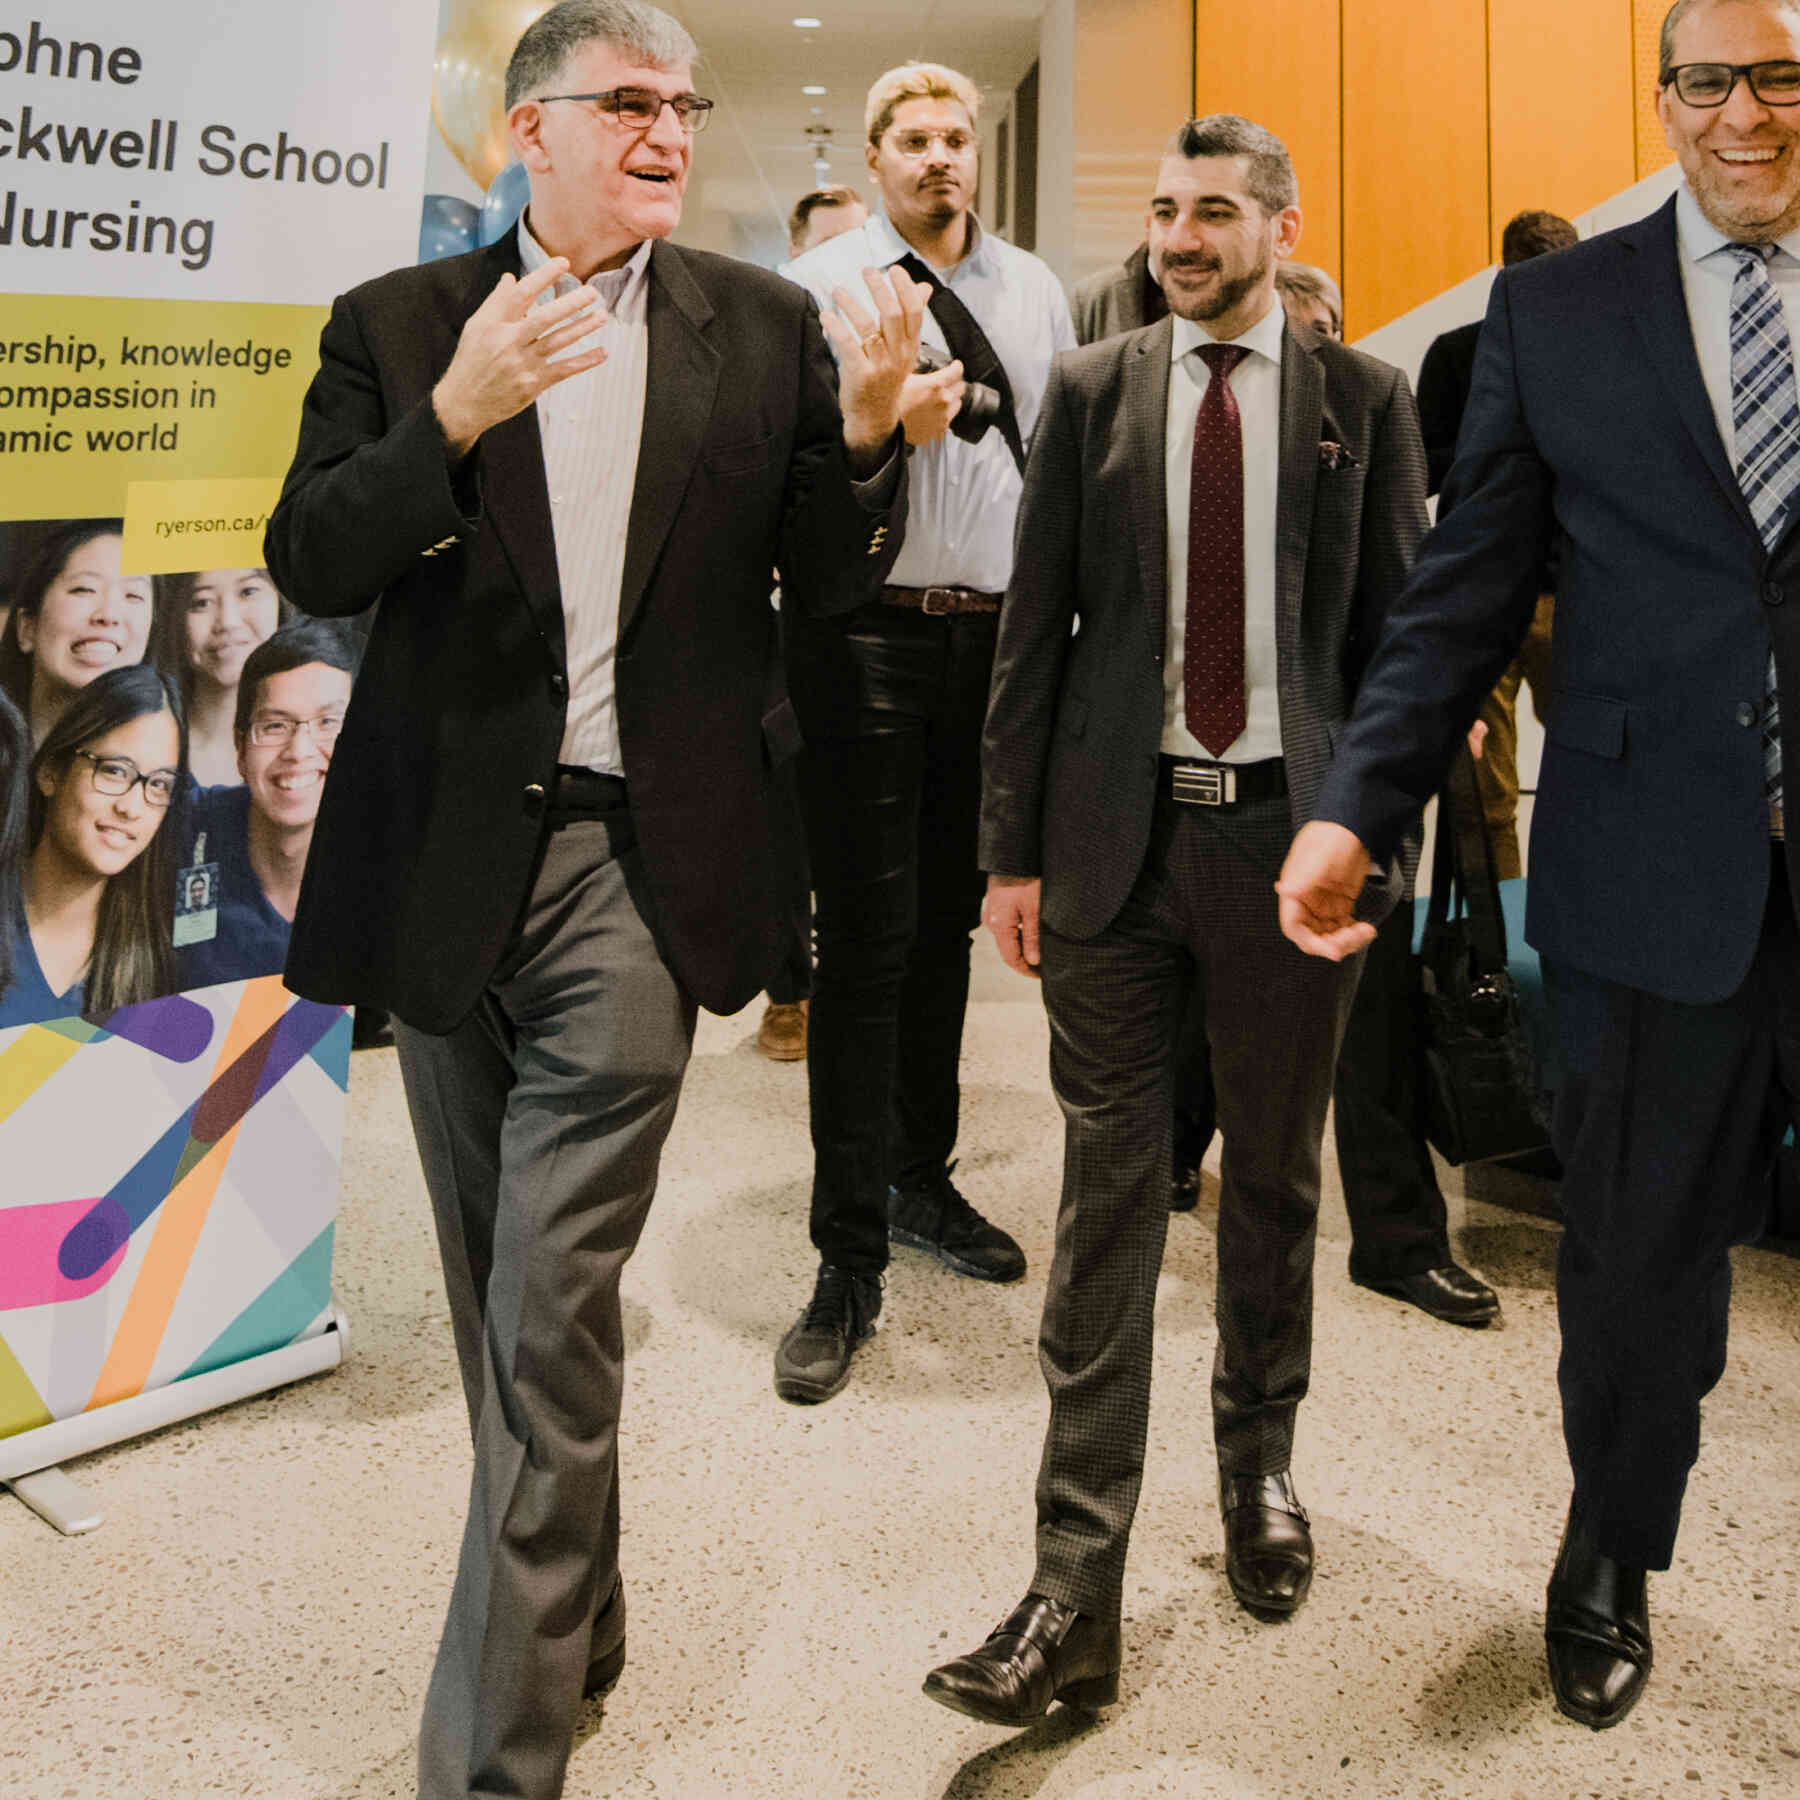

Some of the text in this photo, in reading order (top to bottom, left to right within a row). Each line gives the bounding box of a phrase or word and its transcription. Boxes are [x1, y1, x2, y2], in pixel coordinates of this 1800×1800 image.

[198, 124, 390, 190] School
[121, 337, 292, 375] knowledge
[190, 380, 216, 408] in
[86, 422, 178, 453] world
[155, 513, 269, 539] ryerson.ca/
